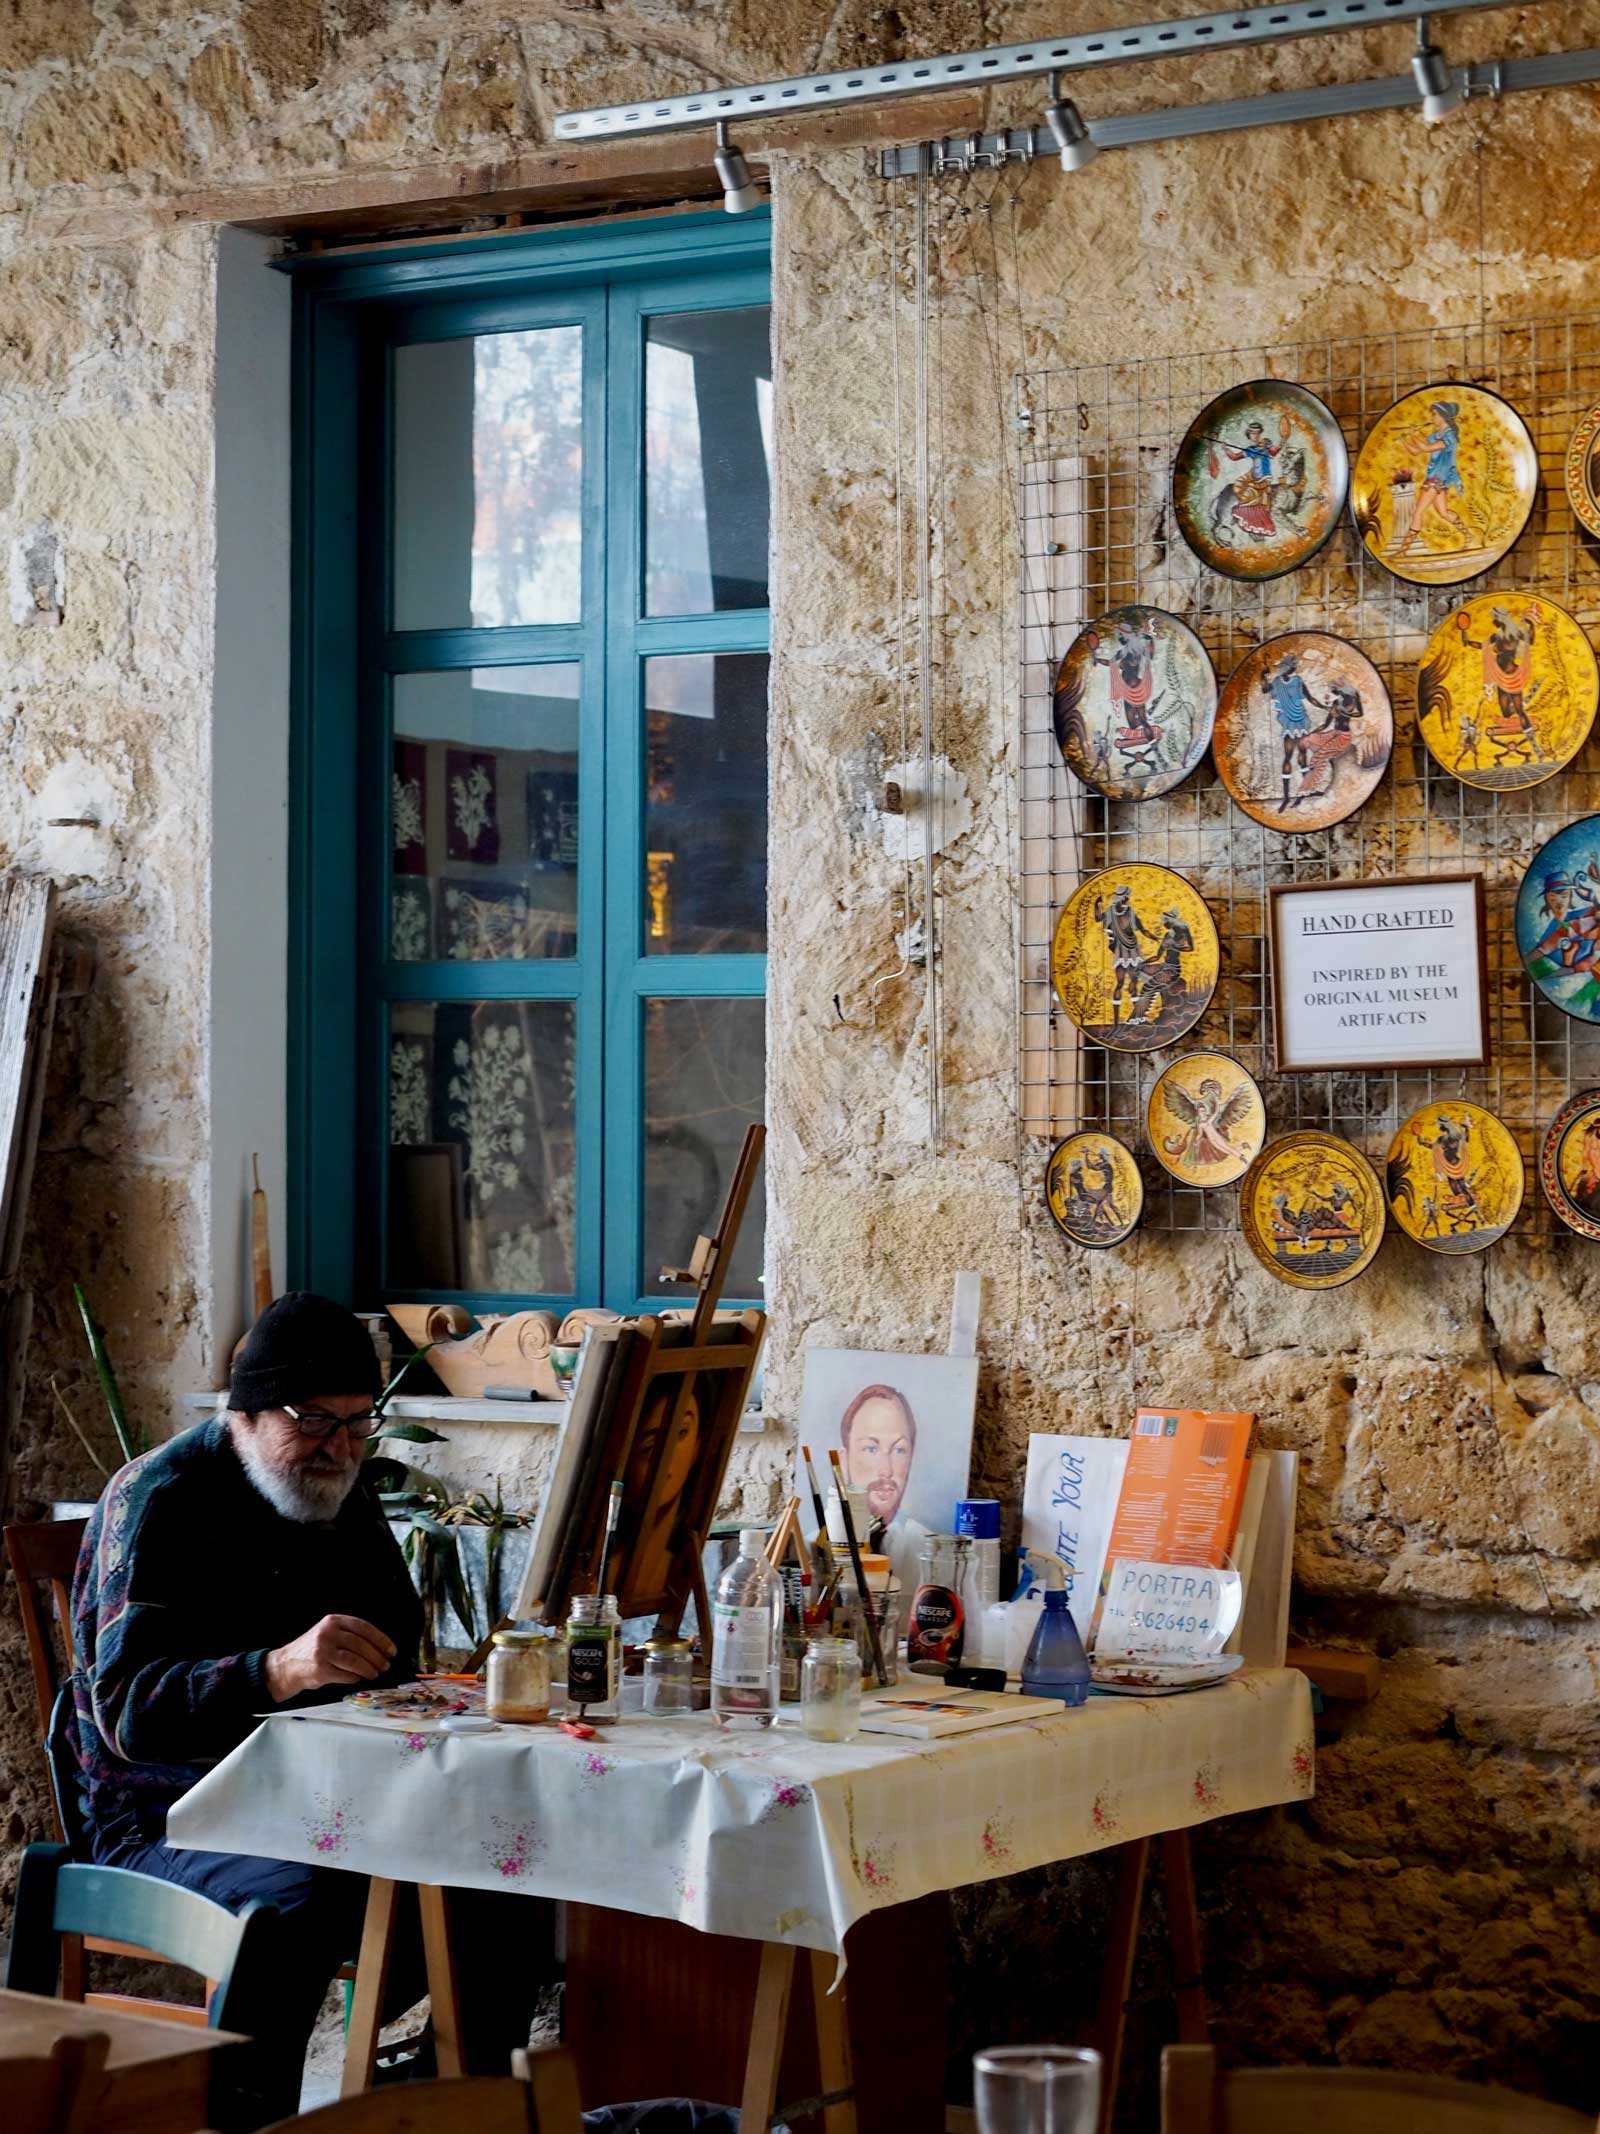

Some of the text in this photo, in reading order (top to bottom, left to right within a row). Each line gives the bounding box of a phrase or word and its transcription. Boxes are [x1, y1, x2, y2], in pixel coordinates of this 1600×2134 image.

[1302, 908, 1454, 933] HAND CRAFTED
[1312, 964, 1449, 984] INSPIRED BY THE
[1303, 986, 1459, 1007] ORIGINAL MUSEUM
[1337, 1010, 1428, 1028] ARTIFACTS
[1051, 1452, 1085, 1511] YOUR
[574, 1657, 601, 1666] GOLD
